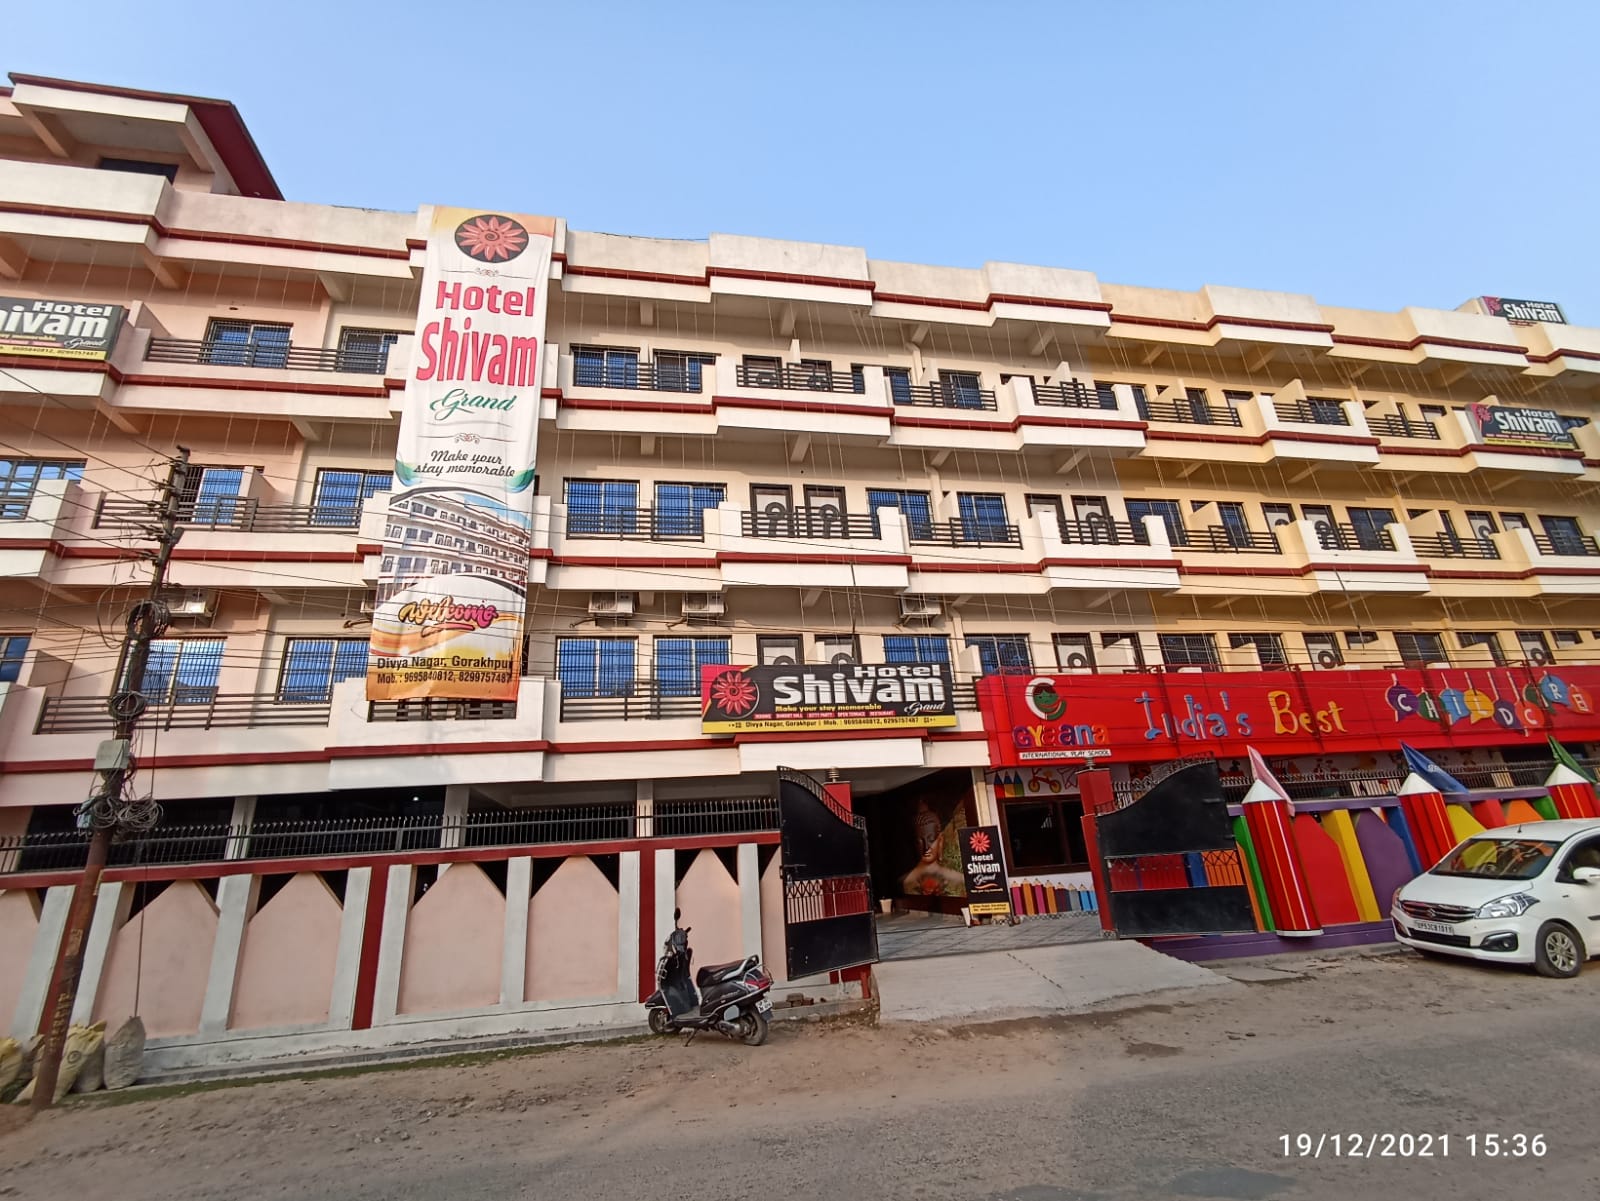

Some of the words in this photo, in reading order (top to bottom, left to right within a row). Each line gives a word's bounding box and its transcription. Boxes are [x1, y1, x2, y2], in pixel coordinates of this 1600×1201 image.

[435, 280, 536, 317] Hotel
[32, 301, 113, 317] Hotel
[1502, 303, 1563, 322] Shivam
[416, 317, 538, 387] Shivam
[429, 388, 518, 421] Grand
[1520, 408, 1557, 420] Hotel
[1493, 411, 1565, 435] Shivam
[430, 450, 468, 462] Make
[470, 452, 503, 466] your
[413, 462, 445, 476] stay
[446, 463, 515, 478] memorable
[376, 657, 408, 671] Divya
[853, 664, 941, 678] Hotel
[773, 673, 946, 705] Shivam
[775, 705, 798, 713] Make
[799, 705, 817, 714] your
[903, 702, 946, 716] Grand
[1133, 690, 1252, 741] India's
[1266, 689, 1349, 736] Best
[971, 854, 994, 862] Hotel
[967, 862, 1001, 875] Shivam
